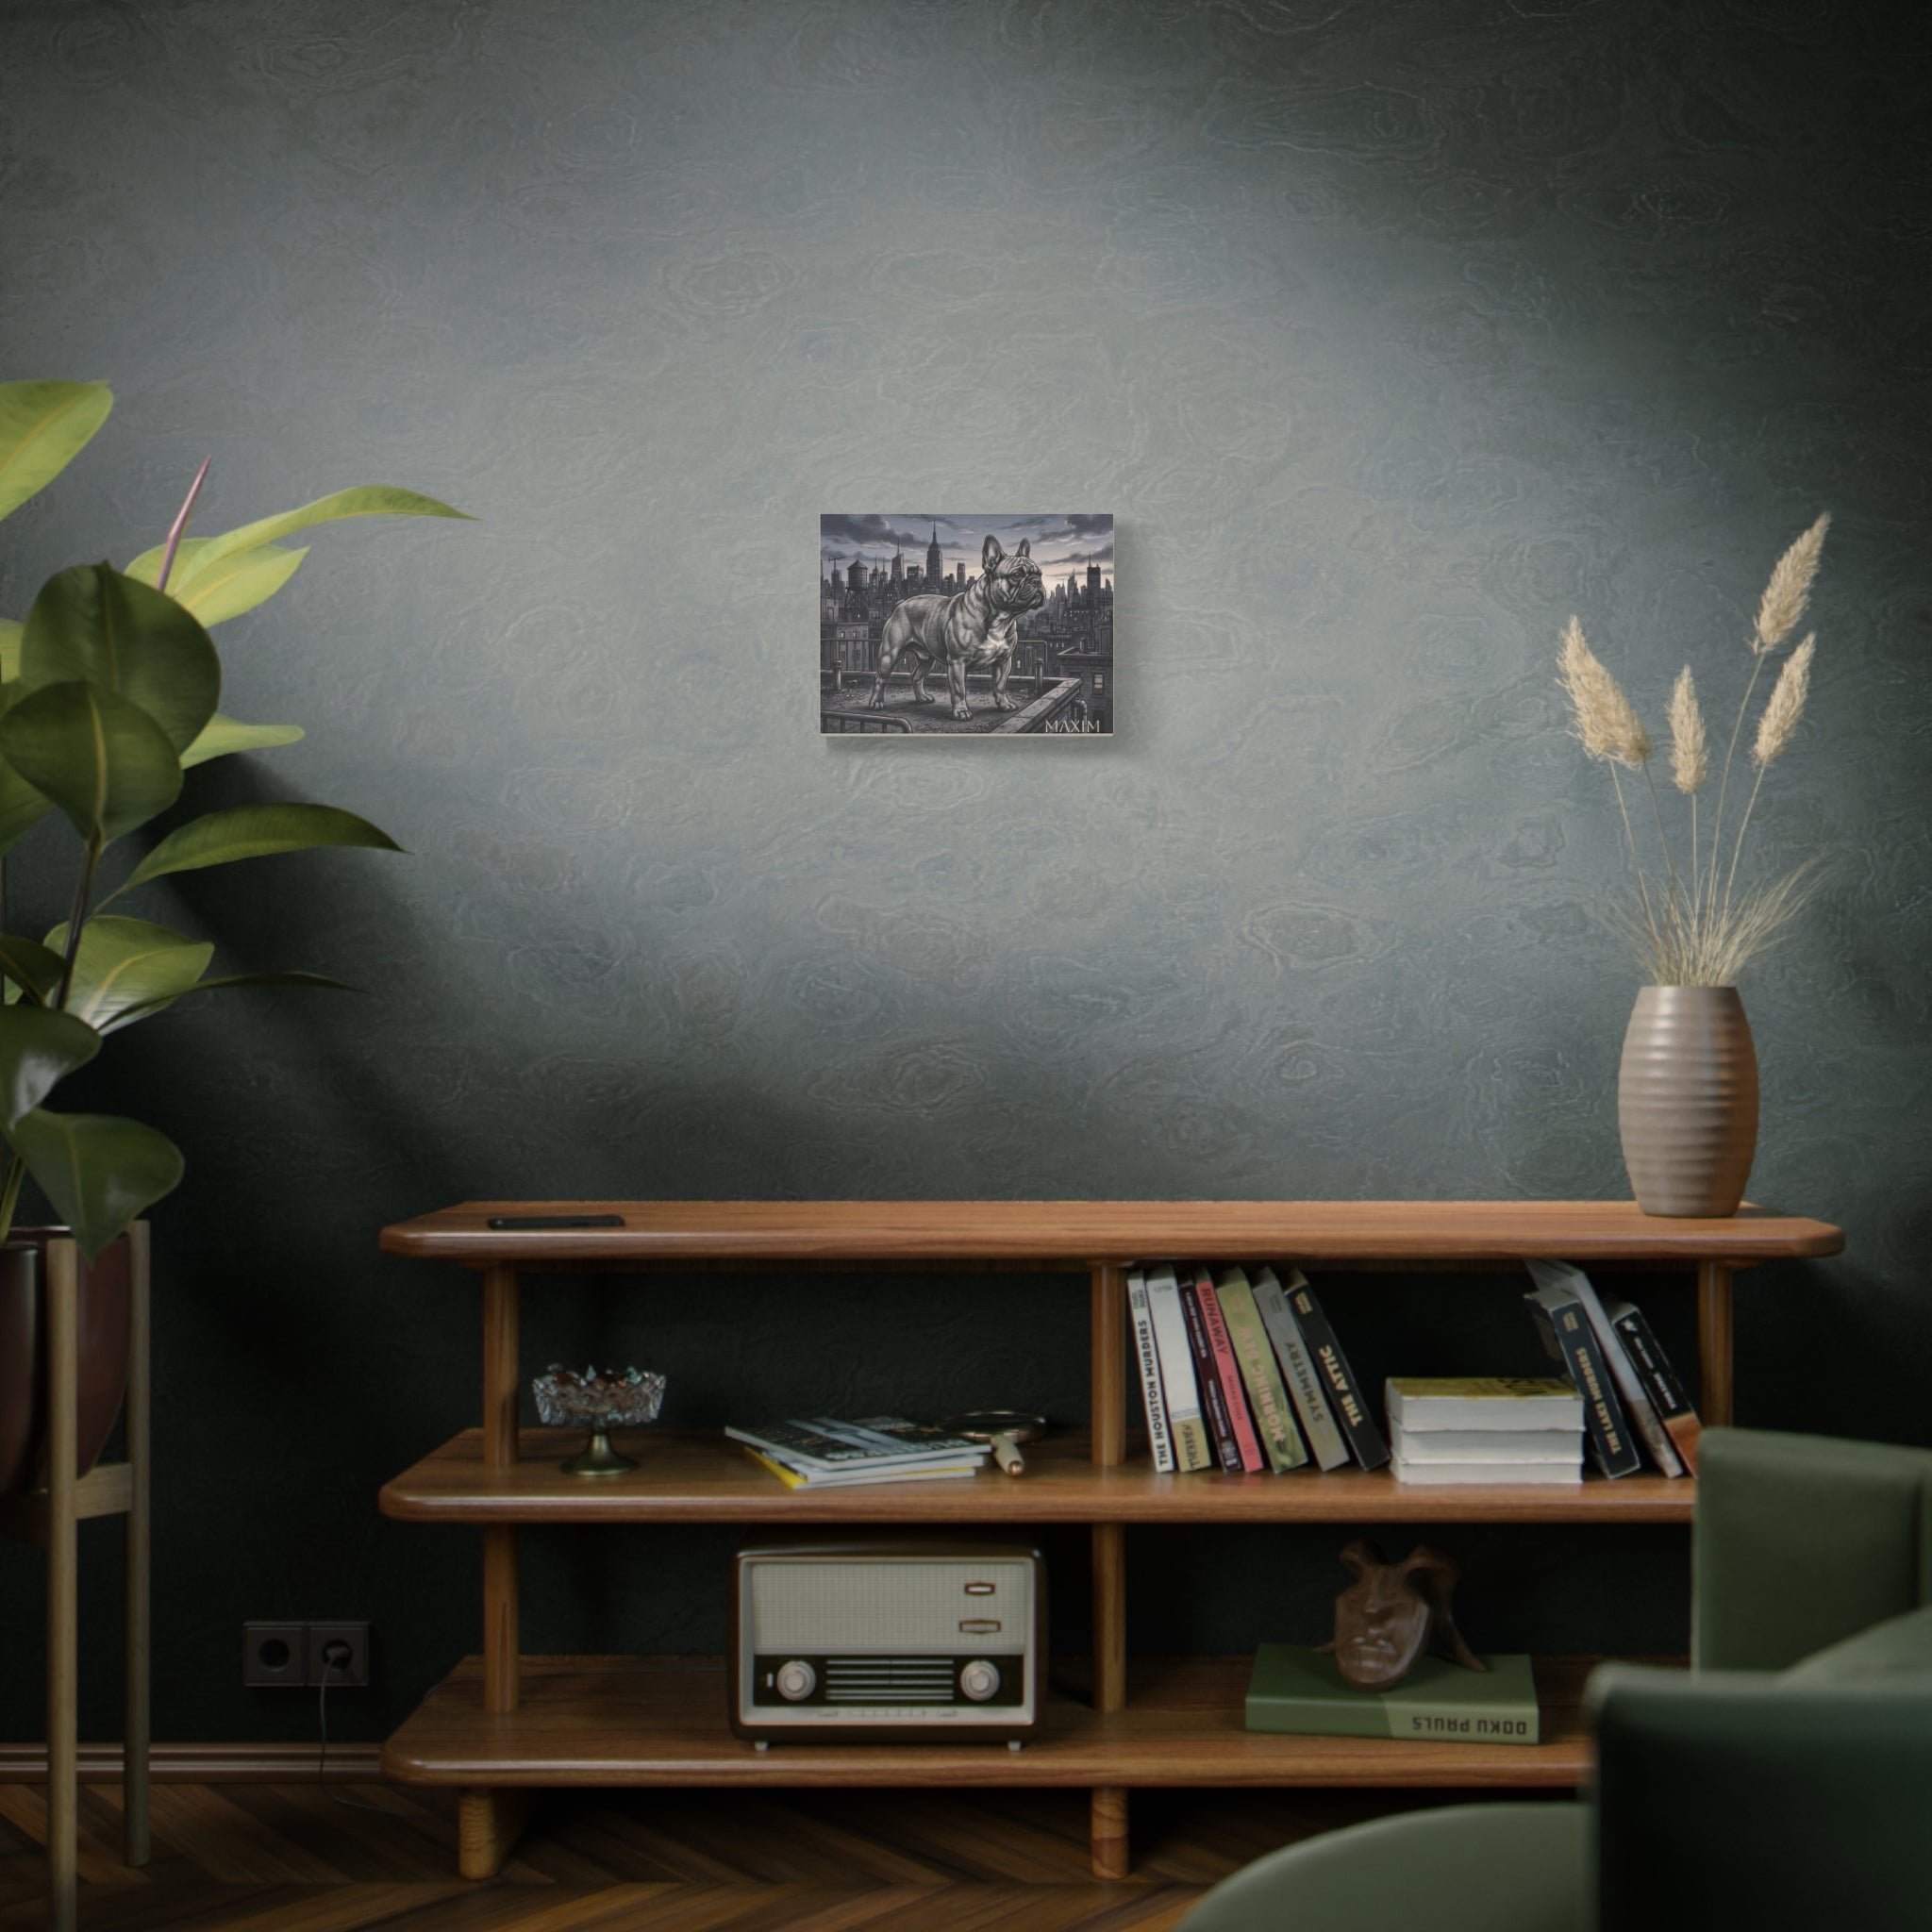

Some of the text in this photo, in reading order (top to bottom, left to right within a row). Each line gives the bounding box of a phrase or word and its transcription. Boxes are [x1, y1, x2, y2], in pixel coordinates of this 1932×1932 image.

[1045, 720, 1100, 732] MAXIM
[1138, 1320, 1155, 1376] MURDERS
[1201, 1288, 1228, 1355] RUNAWAY
[1239, 1326, 1258, 1361] DEW
[1287, 1341, 1321, 1423] SYMMETRY
[1320, 1344, 1363, 1426] THE ATTIC
[1575, 1347, 1604, 1403] MURDERS
[1146, 1380, 1164, 1441] HOUSTON
[1254, 1365, 1286, 1442] MORNING
[1156, 1442, 1169, 1466] THE
[1606, 1432, 1622, 1455] THE
[1411, 1716, 1470, 1733] PAULS
